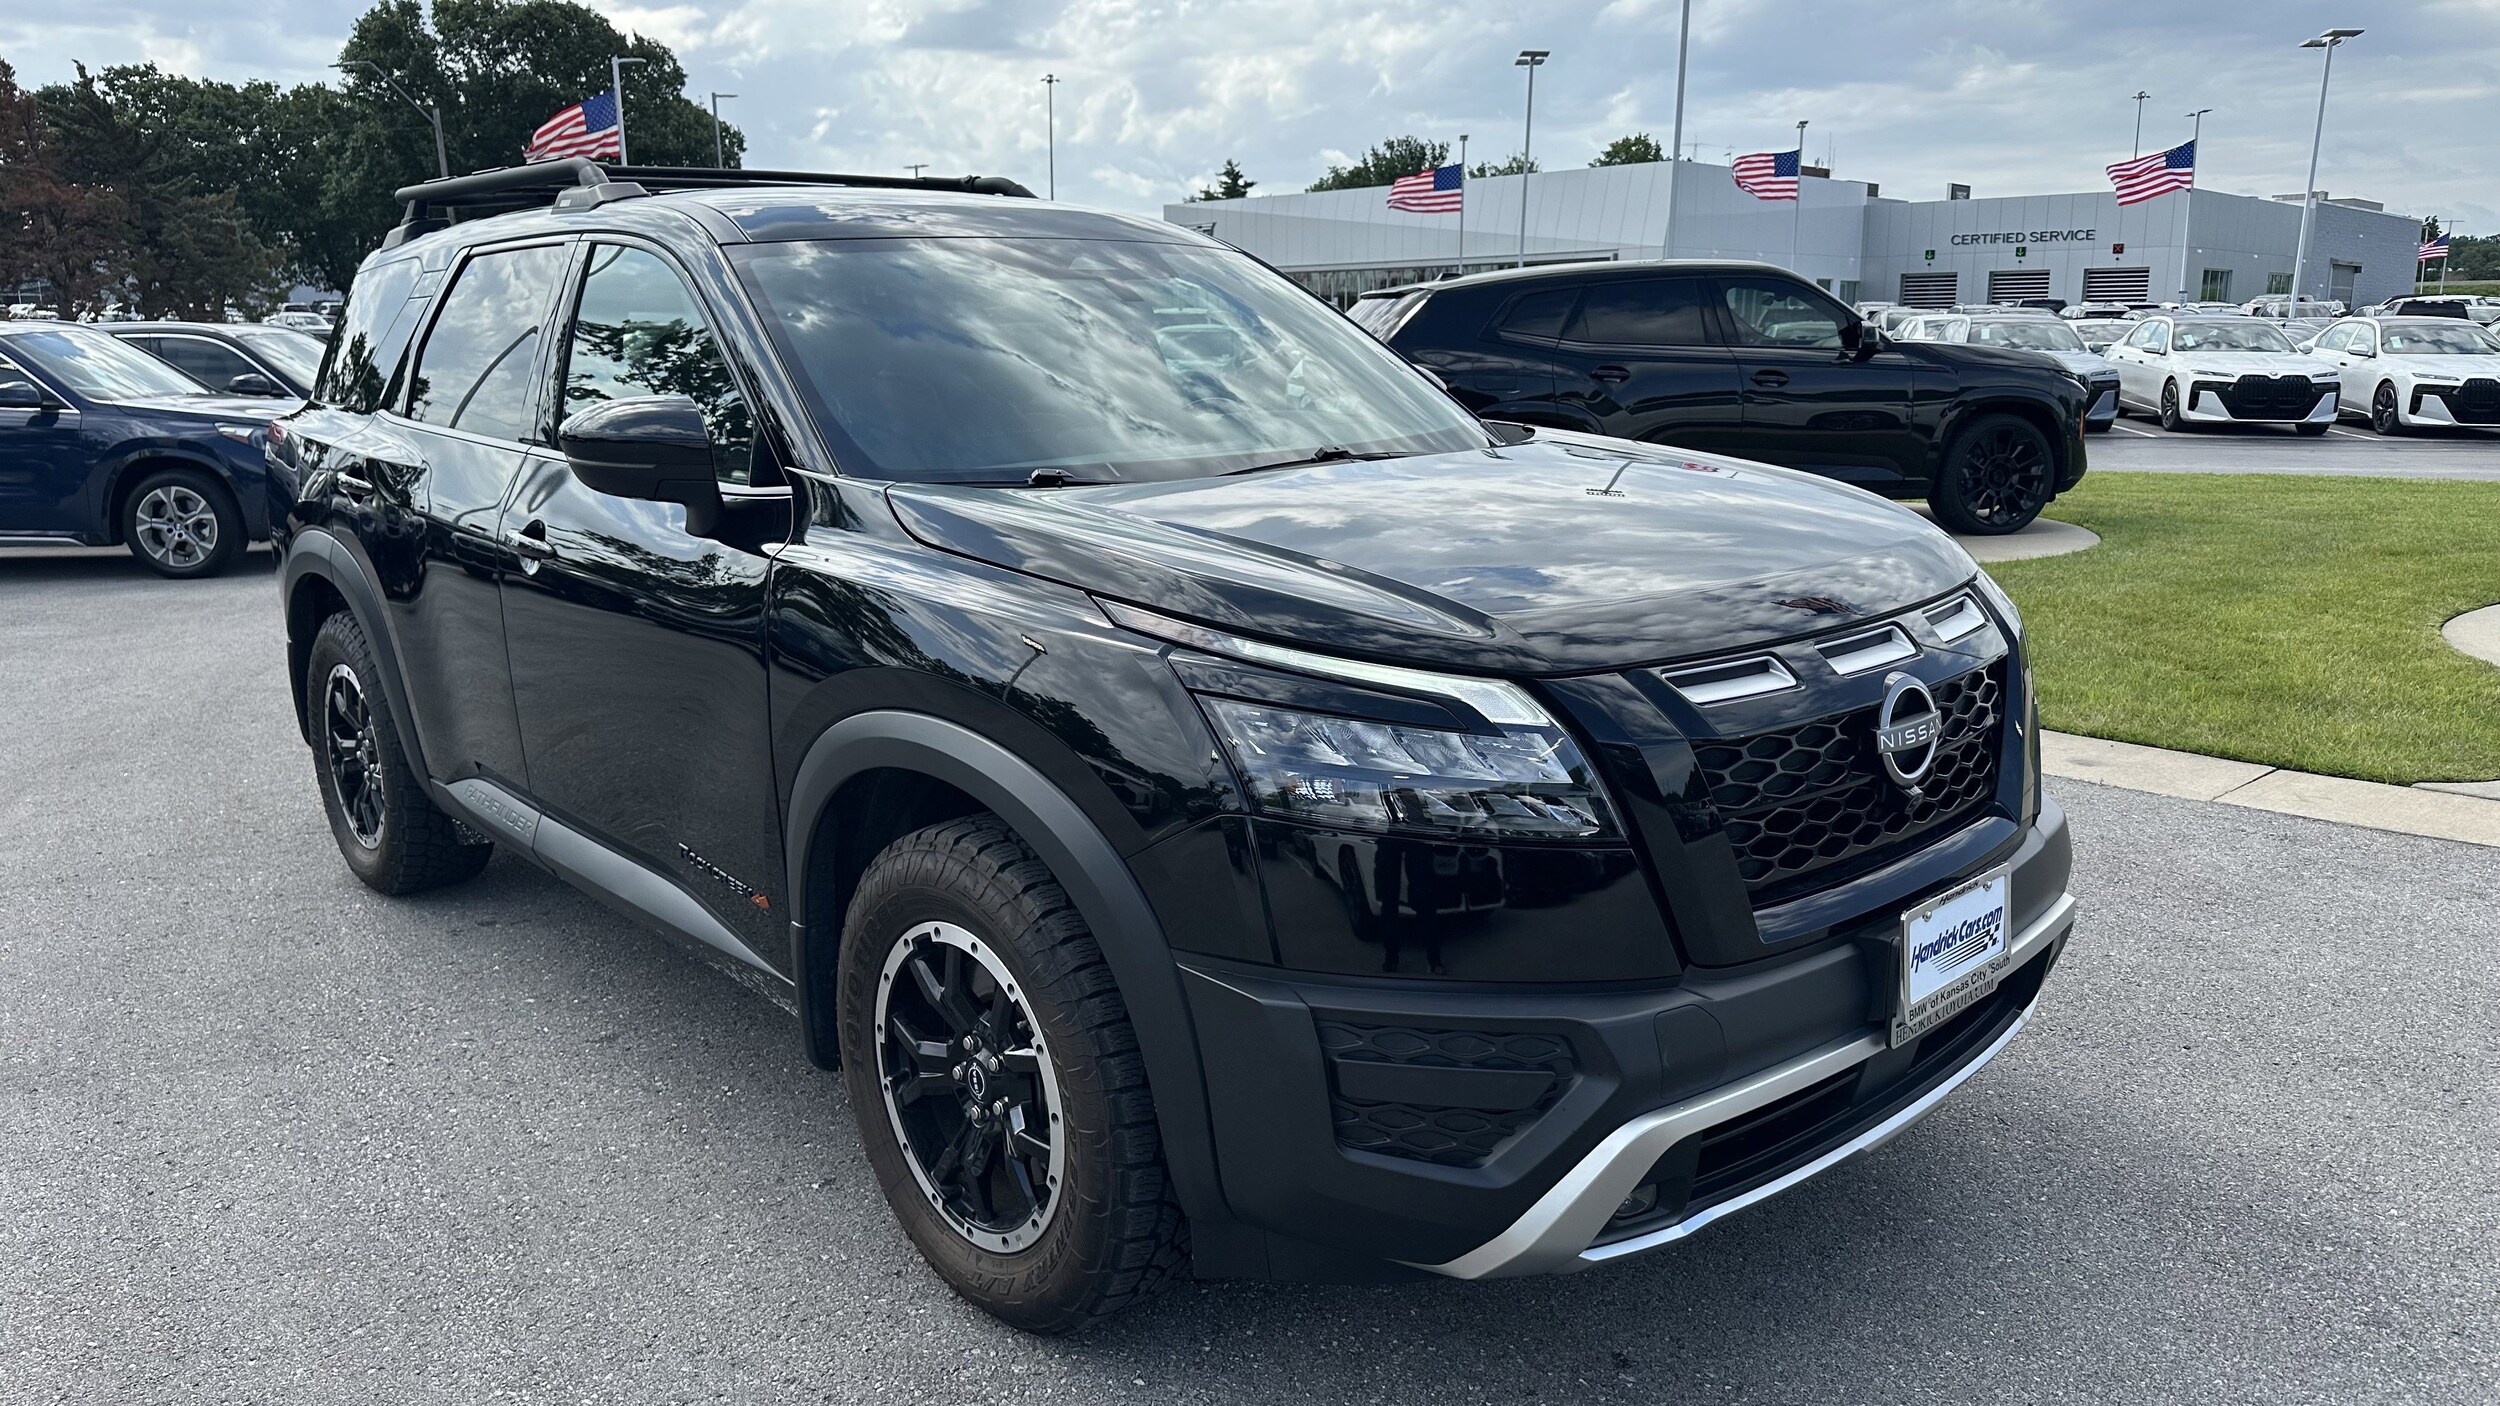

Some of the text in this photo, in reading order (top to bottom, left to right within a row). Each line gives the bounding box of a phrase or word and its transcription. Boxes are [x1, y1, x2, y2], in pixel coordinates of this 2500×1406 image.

[1951, 229, 2096, 246] CERTIFIED SERVICE
[1880, 718, 1942, 750] NISSAN
[463, 783, 535, 836] PATHFINDER
[1908, 955, 2011, 1022] BMW of Kansas City South
